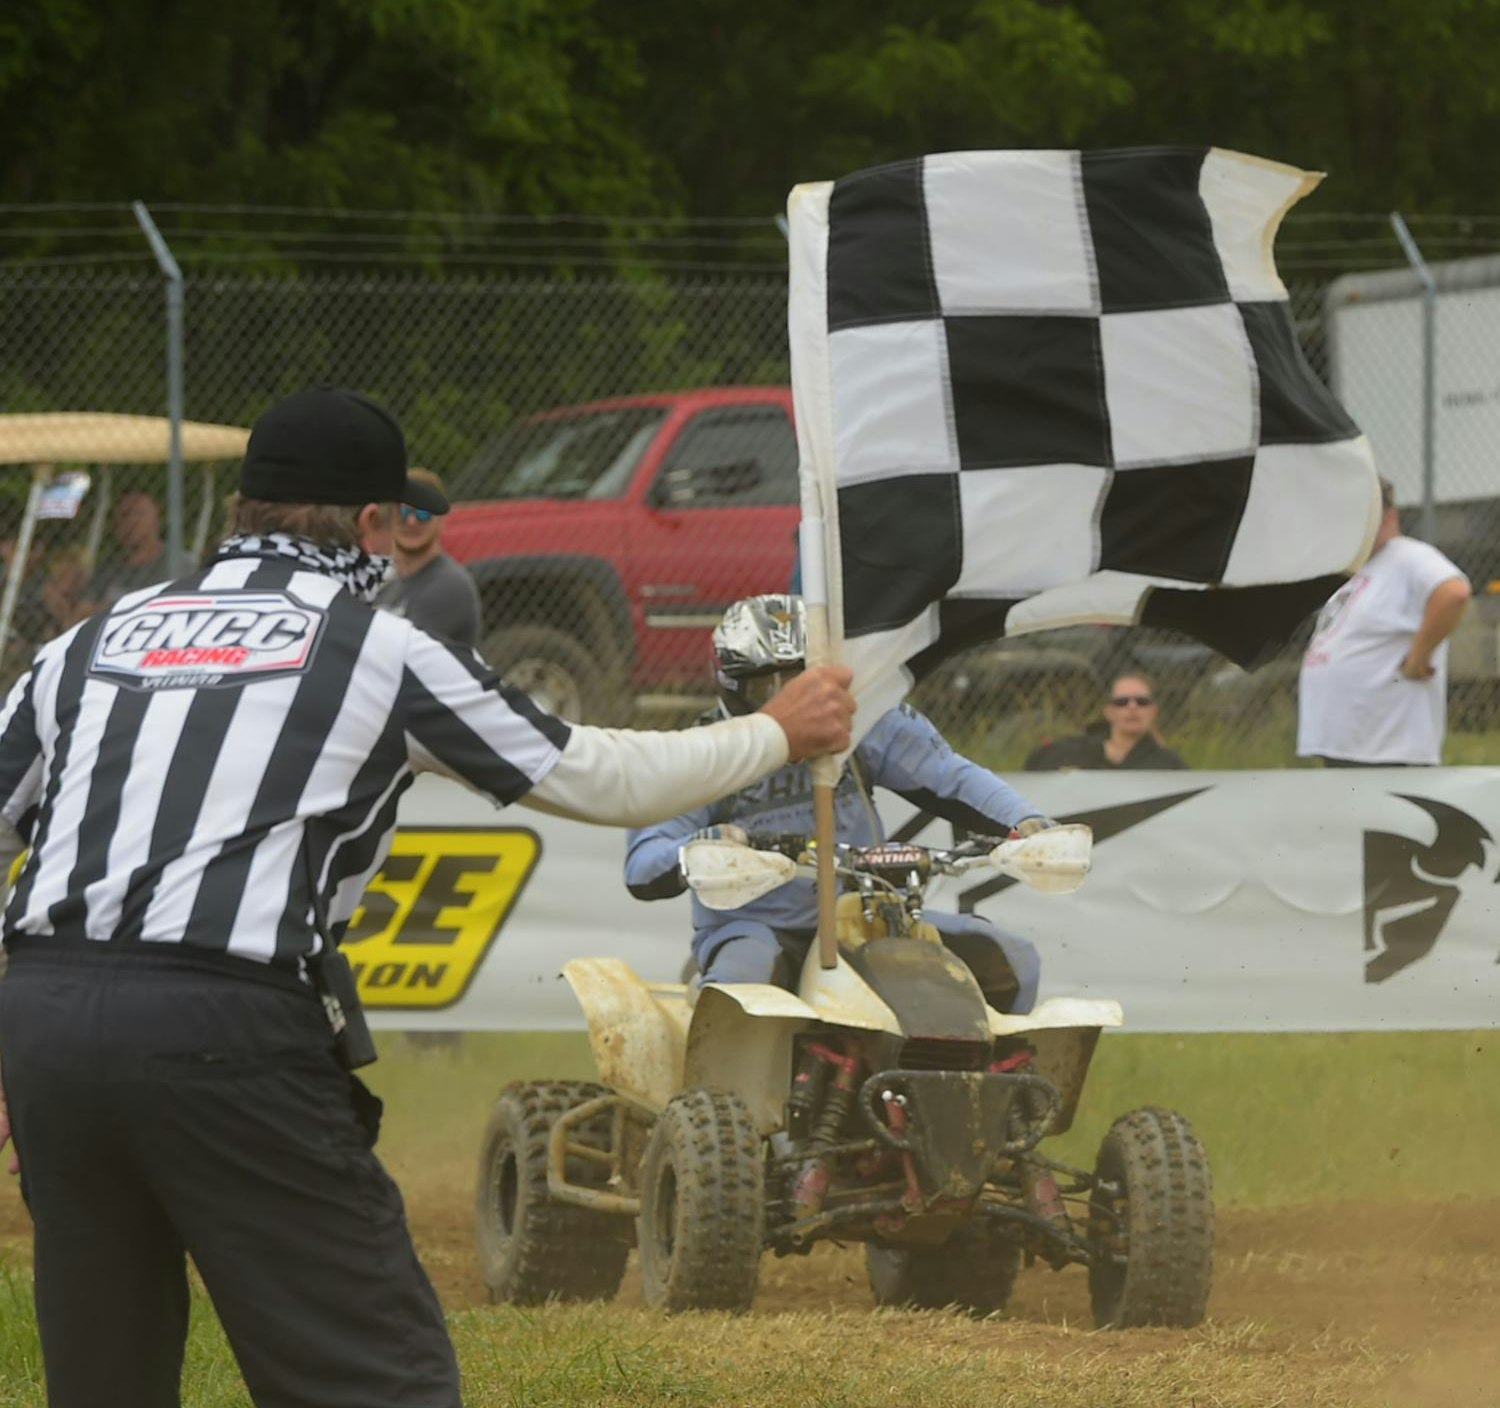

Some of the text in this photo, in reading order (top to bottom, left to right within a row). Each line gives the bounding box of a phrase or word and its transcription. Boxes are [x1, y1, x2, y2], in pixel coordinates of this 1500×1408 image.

[104, 610, 310, 657] GNCC
[141, 647, 247, 667] RACING
[341, 855, 501, 945] SE
[352, 961, 448, 988] ION
